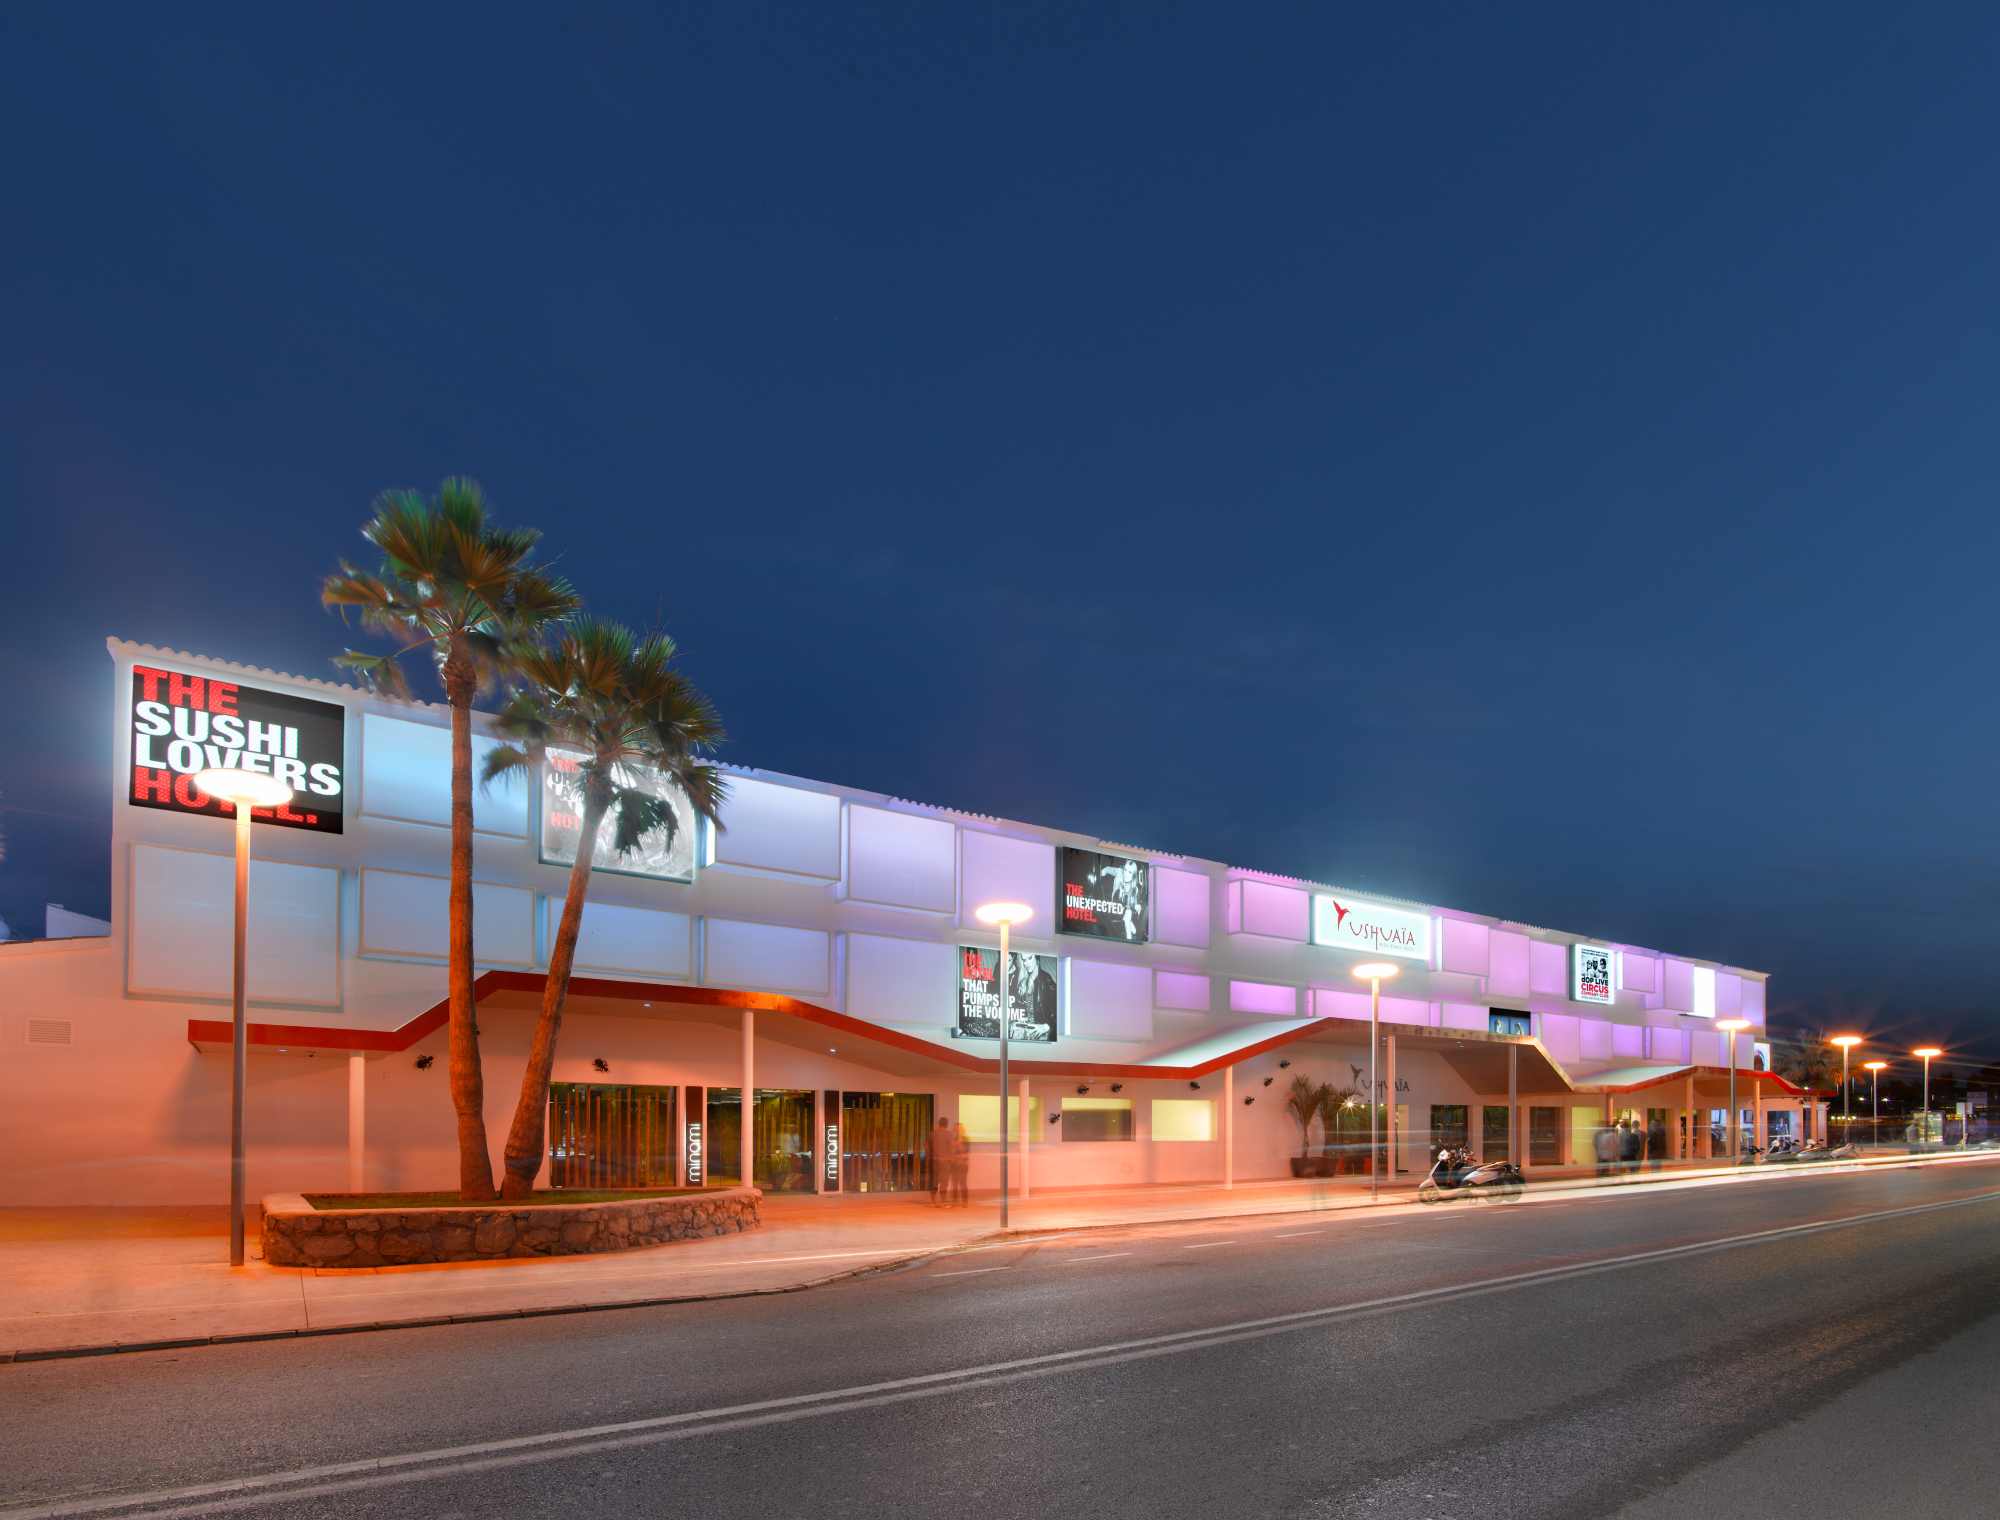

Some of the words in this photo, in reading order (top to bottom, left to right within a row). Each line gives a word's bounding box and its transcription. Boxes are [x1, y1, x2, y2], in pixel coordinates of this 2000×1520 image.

[133, 665, 240, 716] THE
[135, 701, 298, 758] SUSHI
[135, 733, 341, 796] LOVERS
[1066, 895, 1124, 915] UNEXPECTED
[963, 979, 989, 993] THAT
[1581, 983, 1609, 994] CIRCUS
[963, 992, 1000, 1007] PUMPS
[963, 1005, 983, 1018] THE
